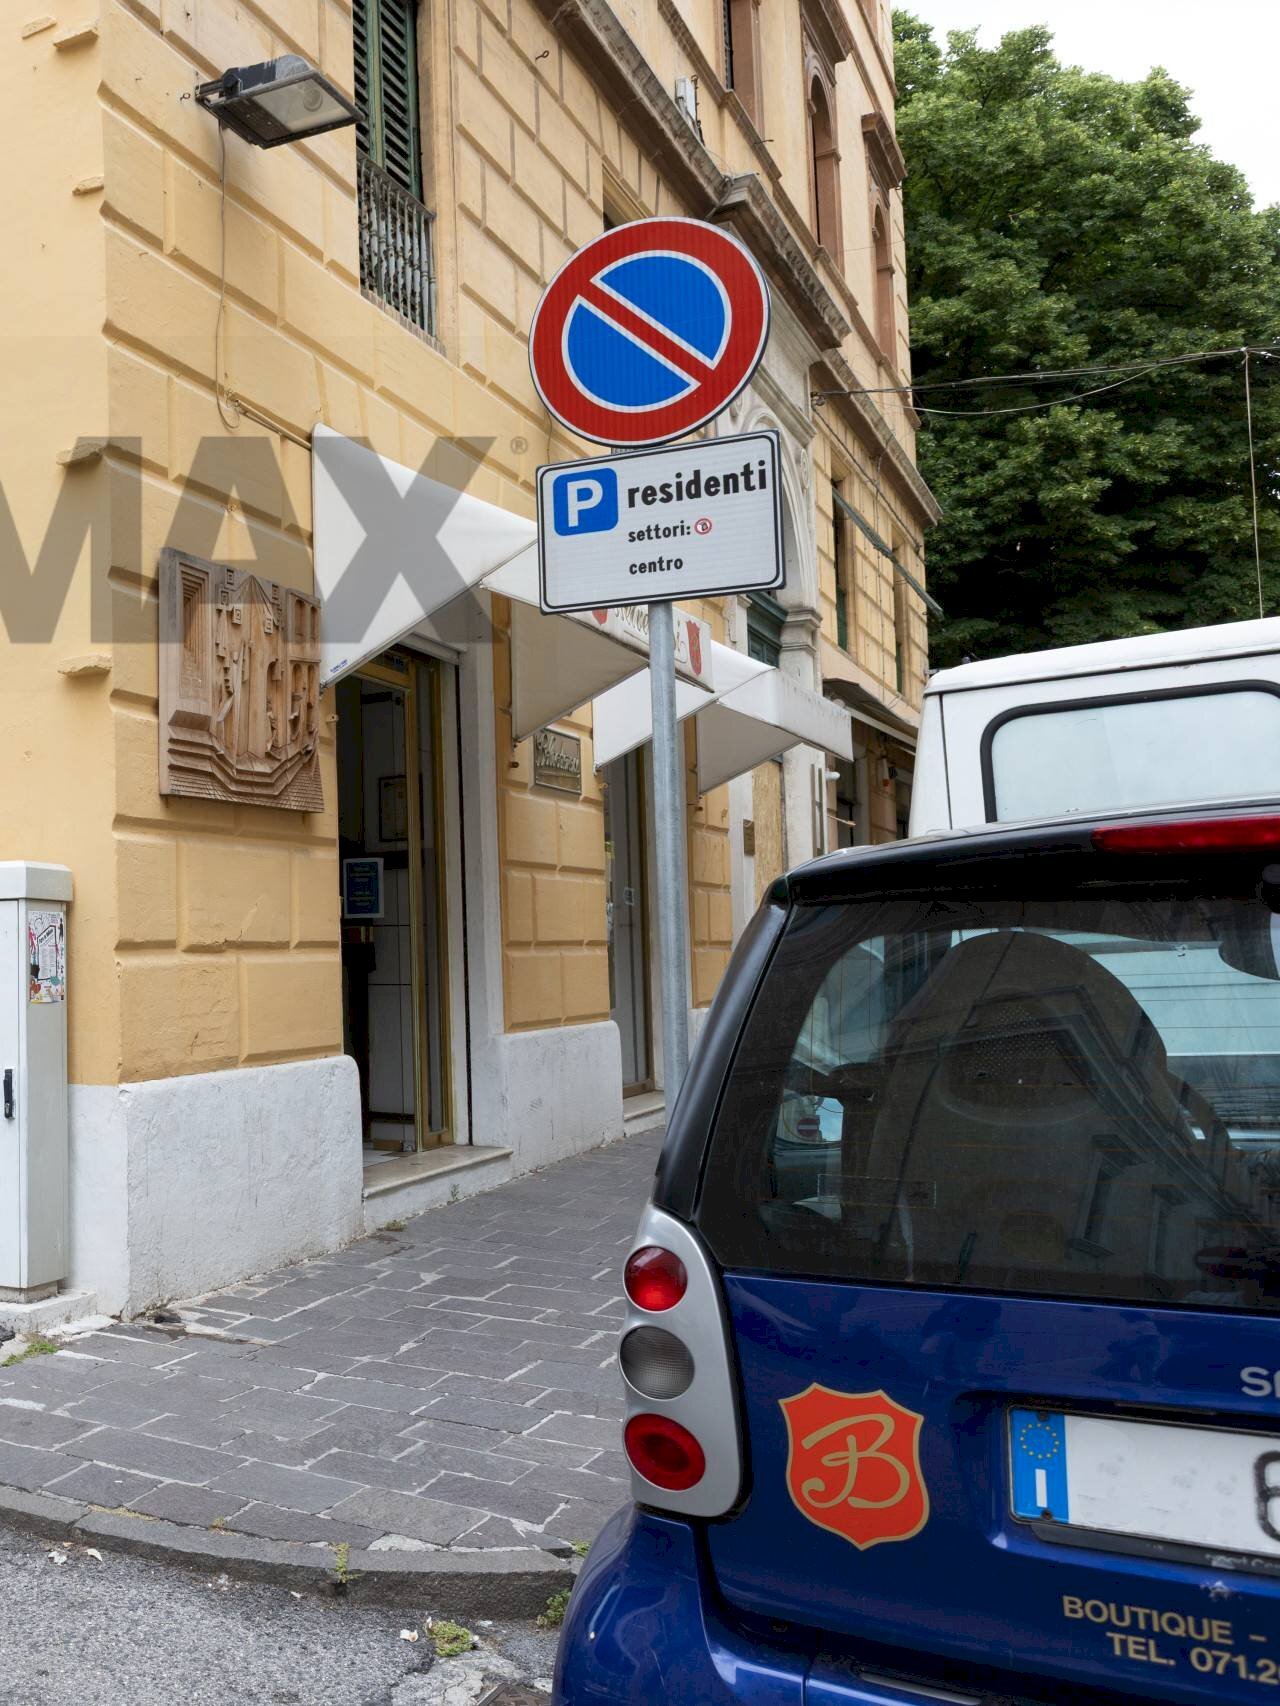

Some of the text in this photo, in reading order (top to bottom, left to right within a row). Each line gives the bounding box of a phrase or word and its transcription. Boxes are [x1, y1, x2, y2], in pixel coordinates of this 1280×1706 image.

[567, 460, 767, 528] P residenti
[628, 519, 691, 543] settori:
[629, 556, 683, 575] centro
[801, 1413, 910, 1509] B
[1062, 1595, 1235, 1645] BOUTIQUE
[1106, 1632, 1280, 1685] TEL. 071.2
